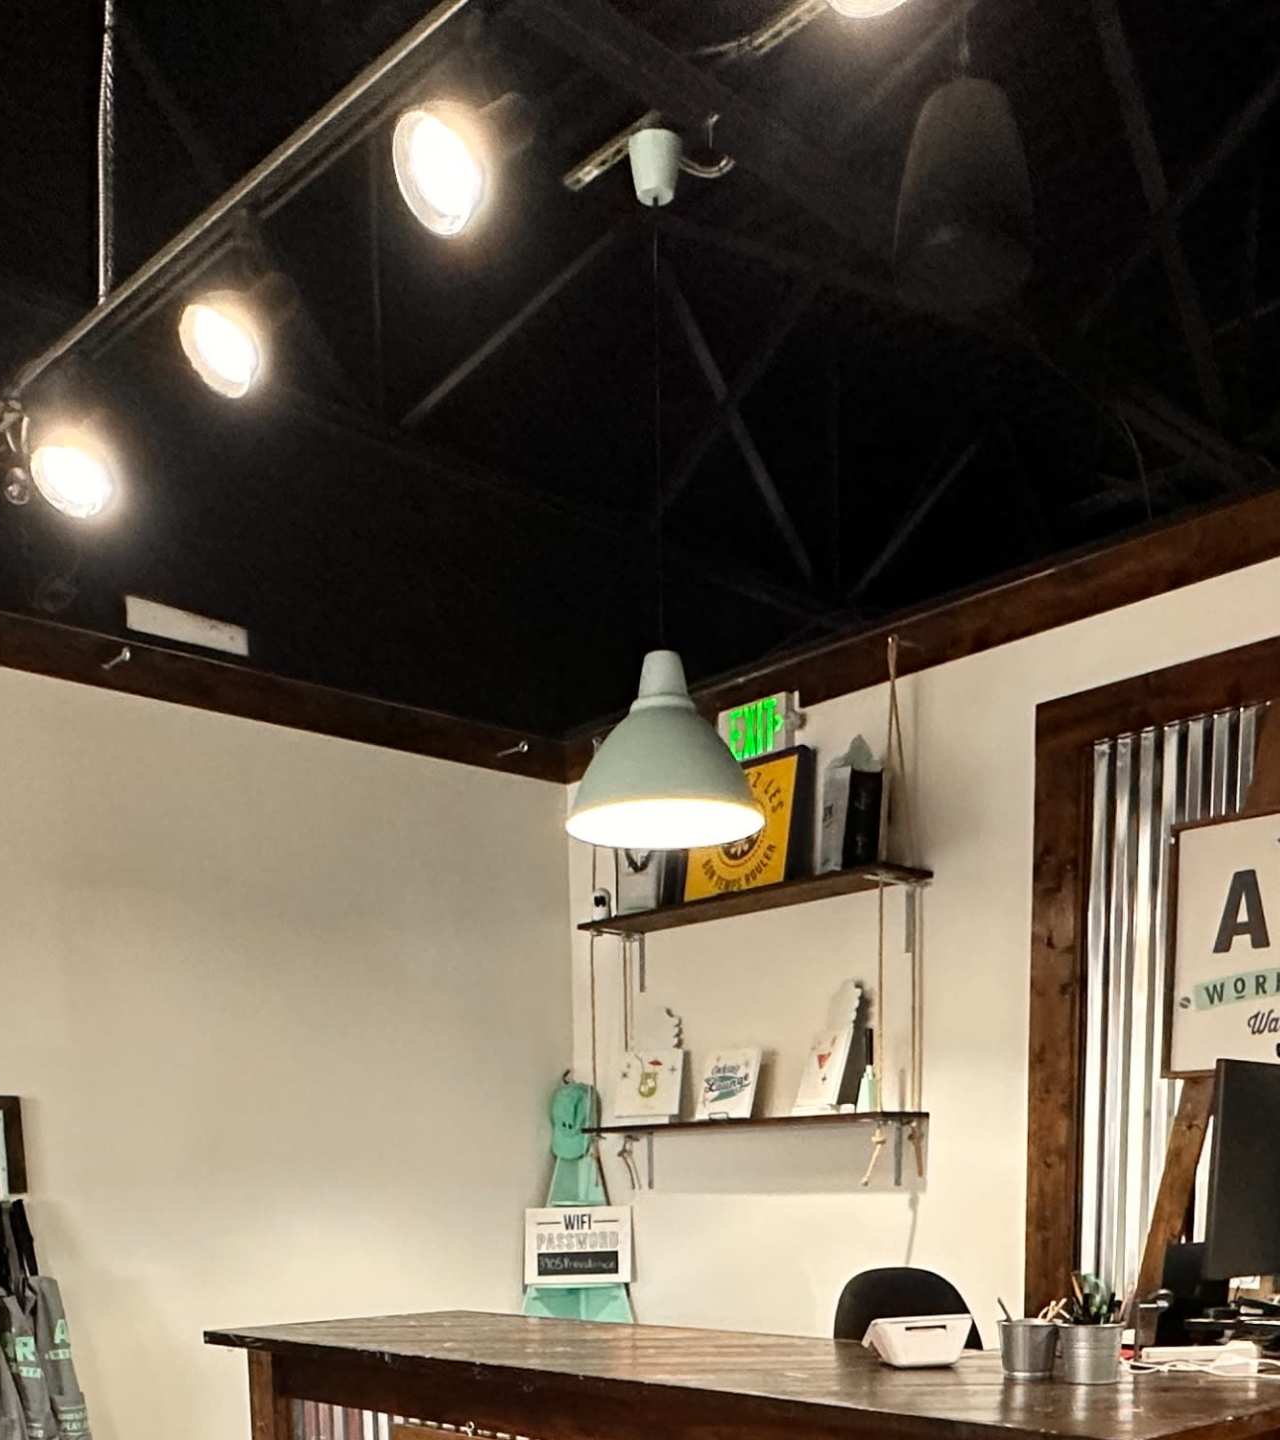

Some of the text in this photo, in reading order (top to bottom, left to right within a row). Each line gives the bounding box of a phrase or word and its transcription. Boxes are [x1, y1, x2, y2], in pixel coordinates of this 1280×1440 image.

[729, 697, 777, 761] EXIT
[564, 1213, 592, 1230] WIFI
[536, 1231, 619, 1251] PASSWORD
